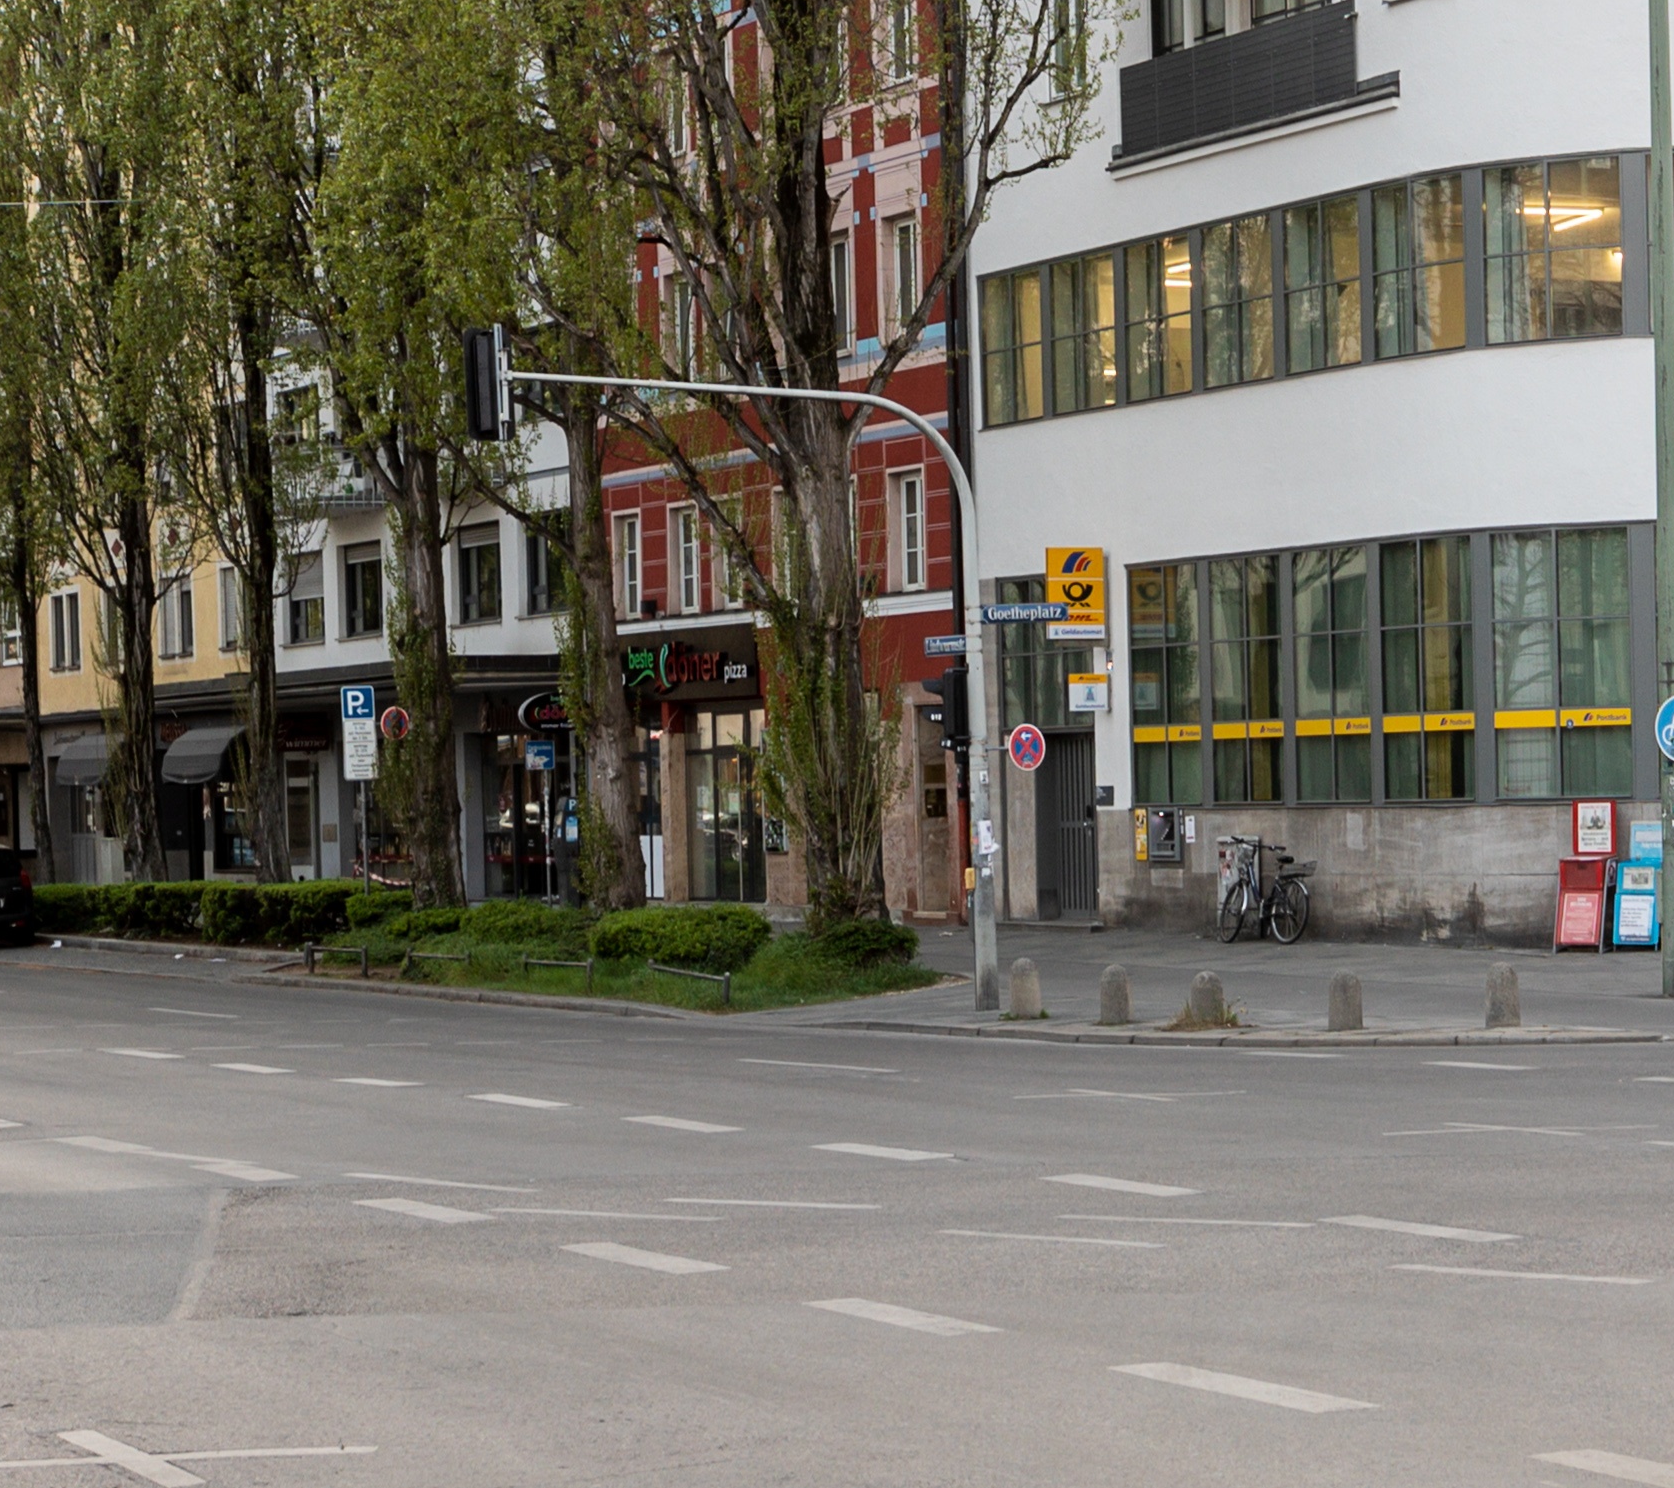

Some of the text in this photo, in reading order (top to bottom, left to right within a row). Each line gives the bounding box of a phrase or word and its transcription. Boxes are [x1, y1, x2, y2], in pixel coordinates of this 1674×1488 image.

[987, 605, 1063, 621] Goetheplatz
[1061, 628, 1103, 636] Geldautomat
[628, 646, 654, 669] beste
[724, 661, 747, 684] pizza
[347, 691, 364, 715] P
